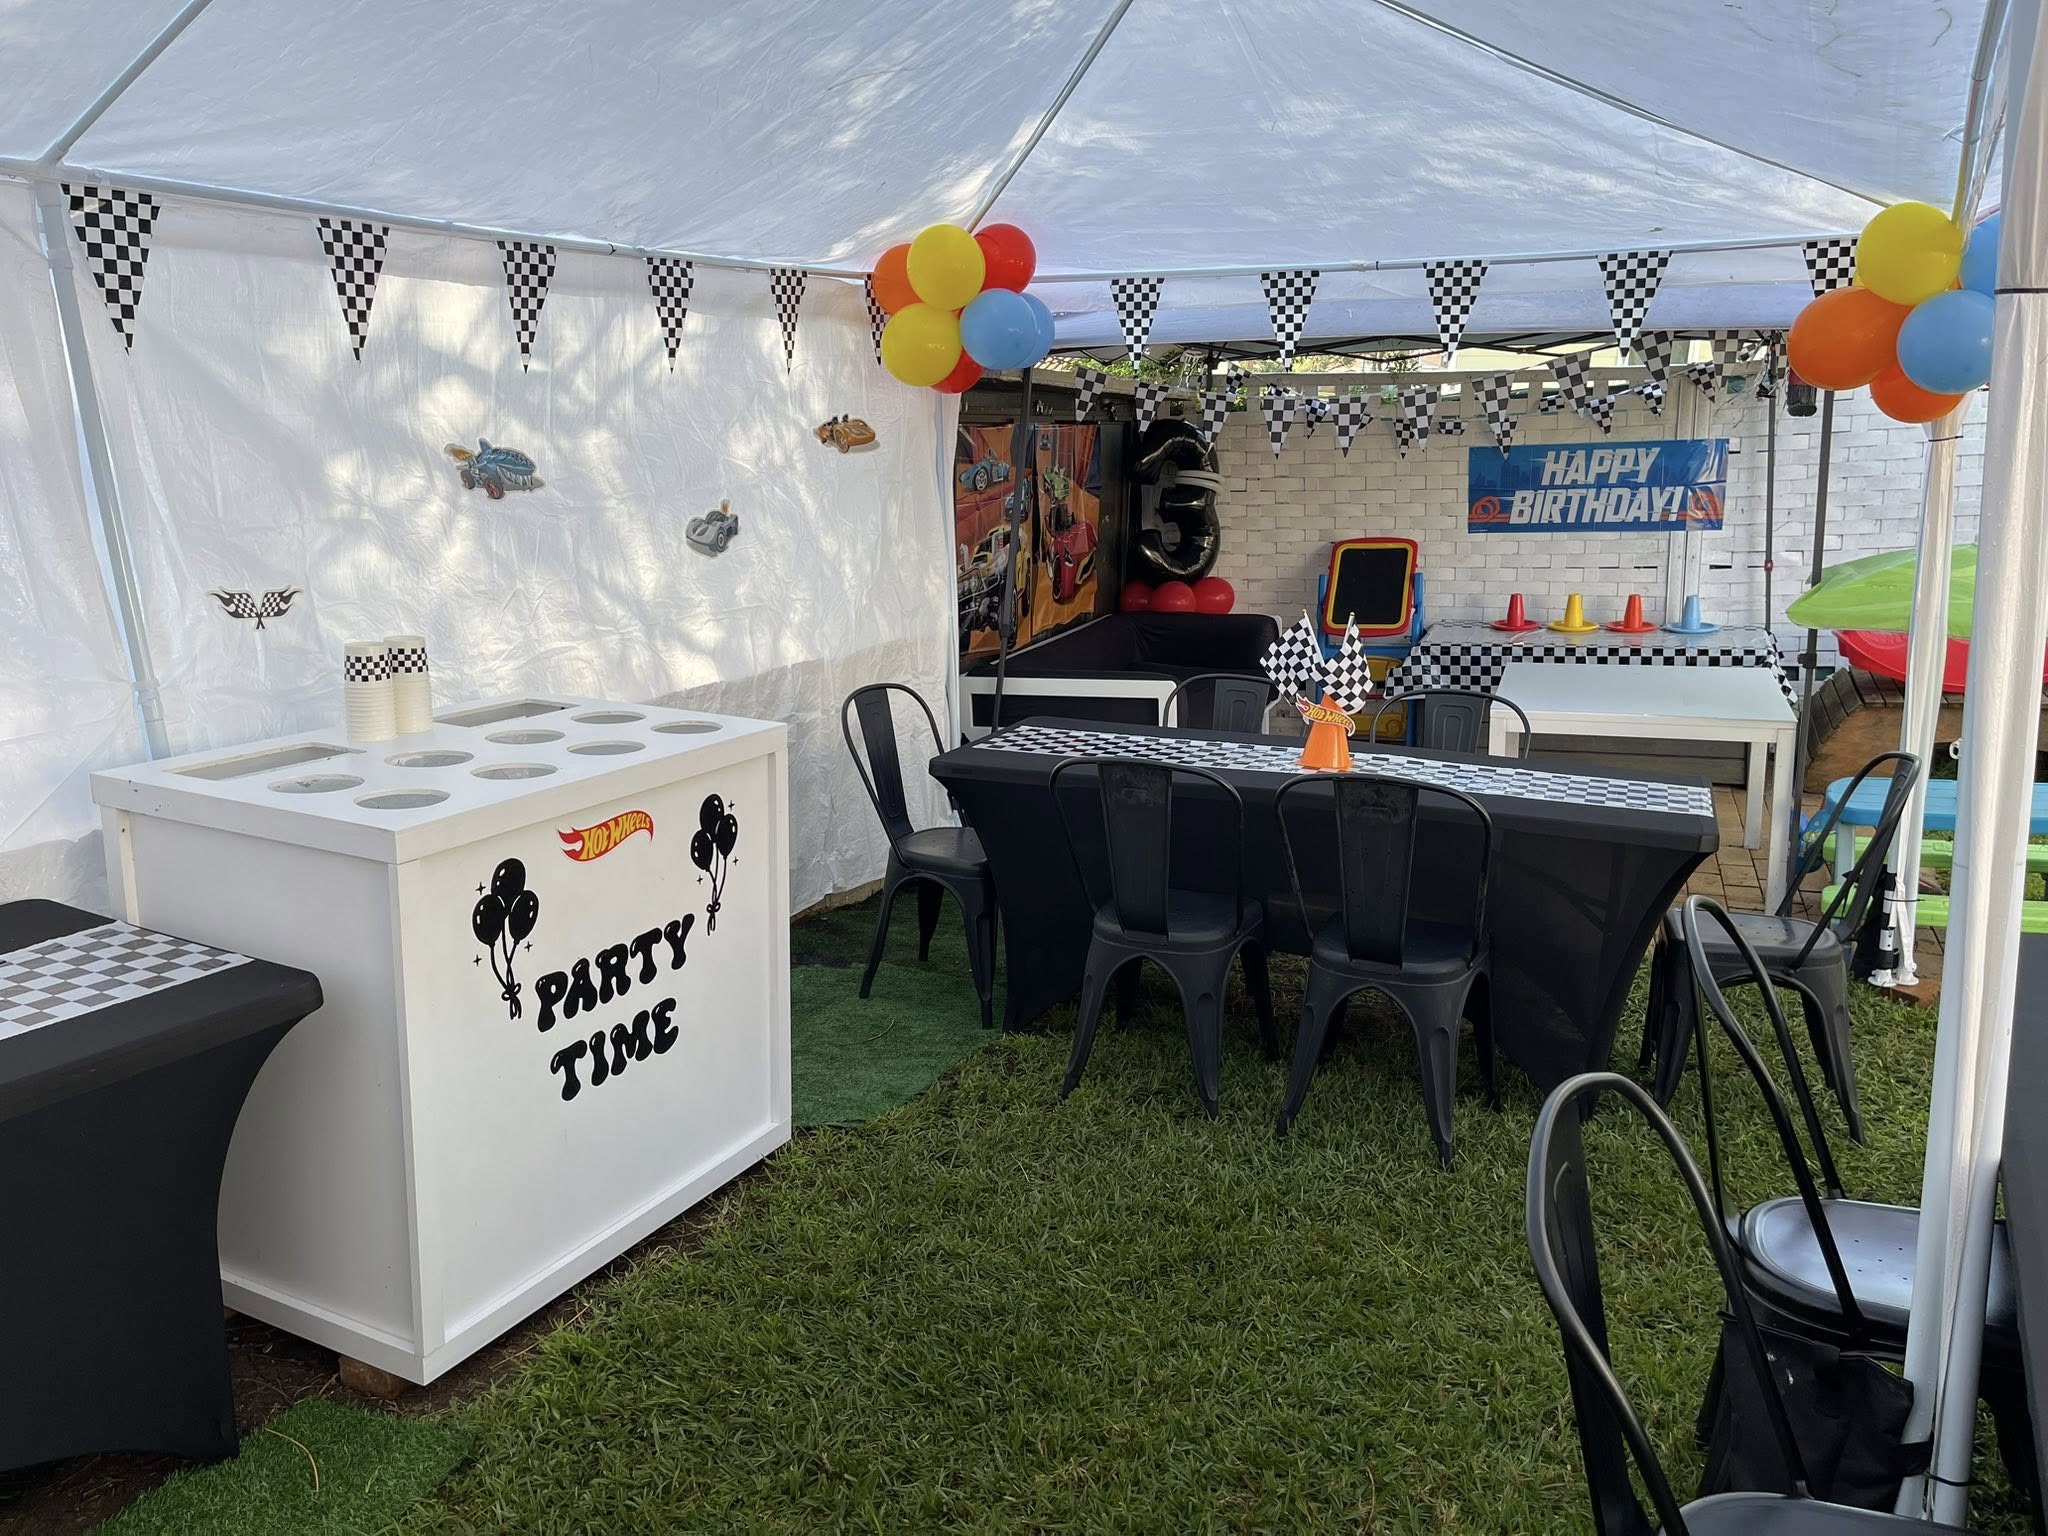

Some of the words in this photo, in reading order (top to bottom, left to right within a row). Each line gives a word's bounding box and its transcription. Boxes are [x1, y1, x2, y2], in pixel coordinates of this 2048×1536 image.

[1541, 447, 1661, 486] HAPPY
[1509, 486, 1685, 524] BIRTHDAY!
[535, 913, 695, 1033] PARTY
[550, 997, 679, 1101] TIME
